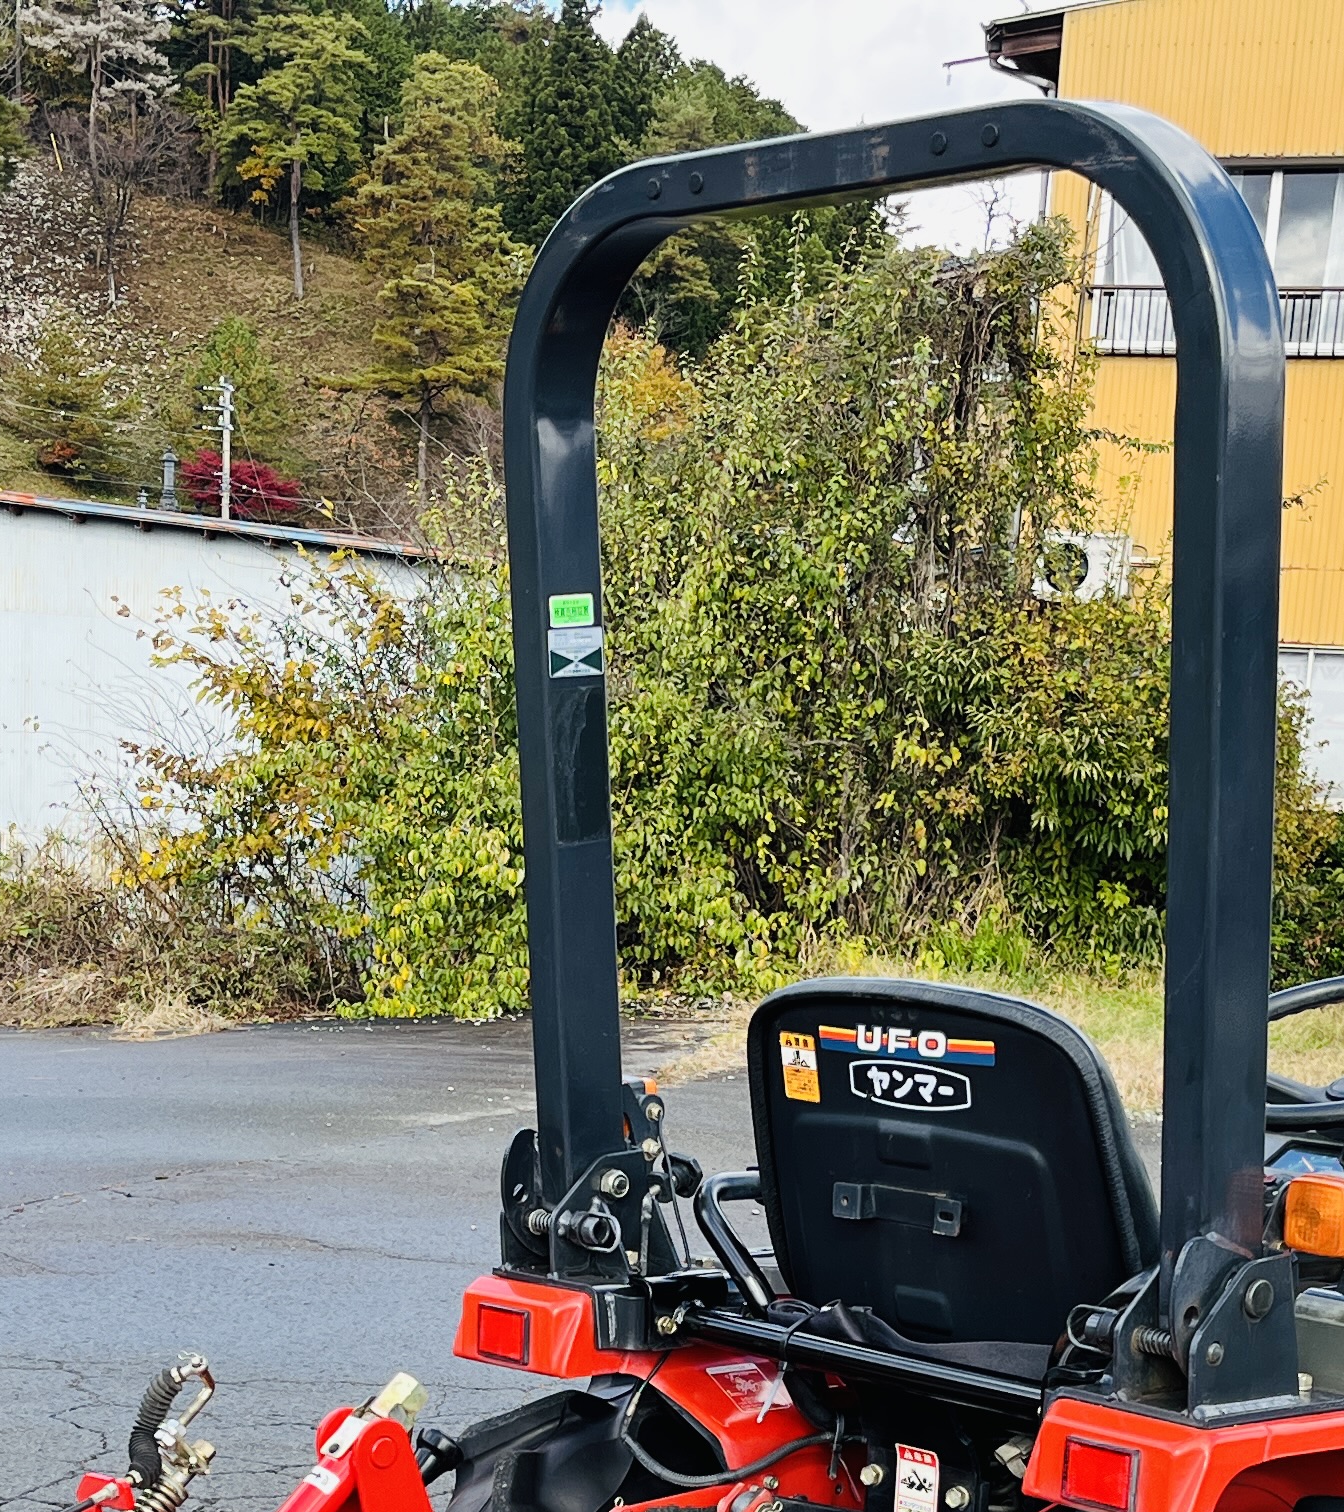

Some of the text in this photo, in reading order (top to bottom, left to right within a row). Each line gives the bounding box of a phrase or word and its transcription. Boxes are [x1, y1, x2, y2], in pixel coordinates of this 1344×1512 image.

[857, 1024, 946, 1058] UFO
[867, 1066, 954, 1103] ヤンマー
